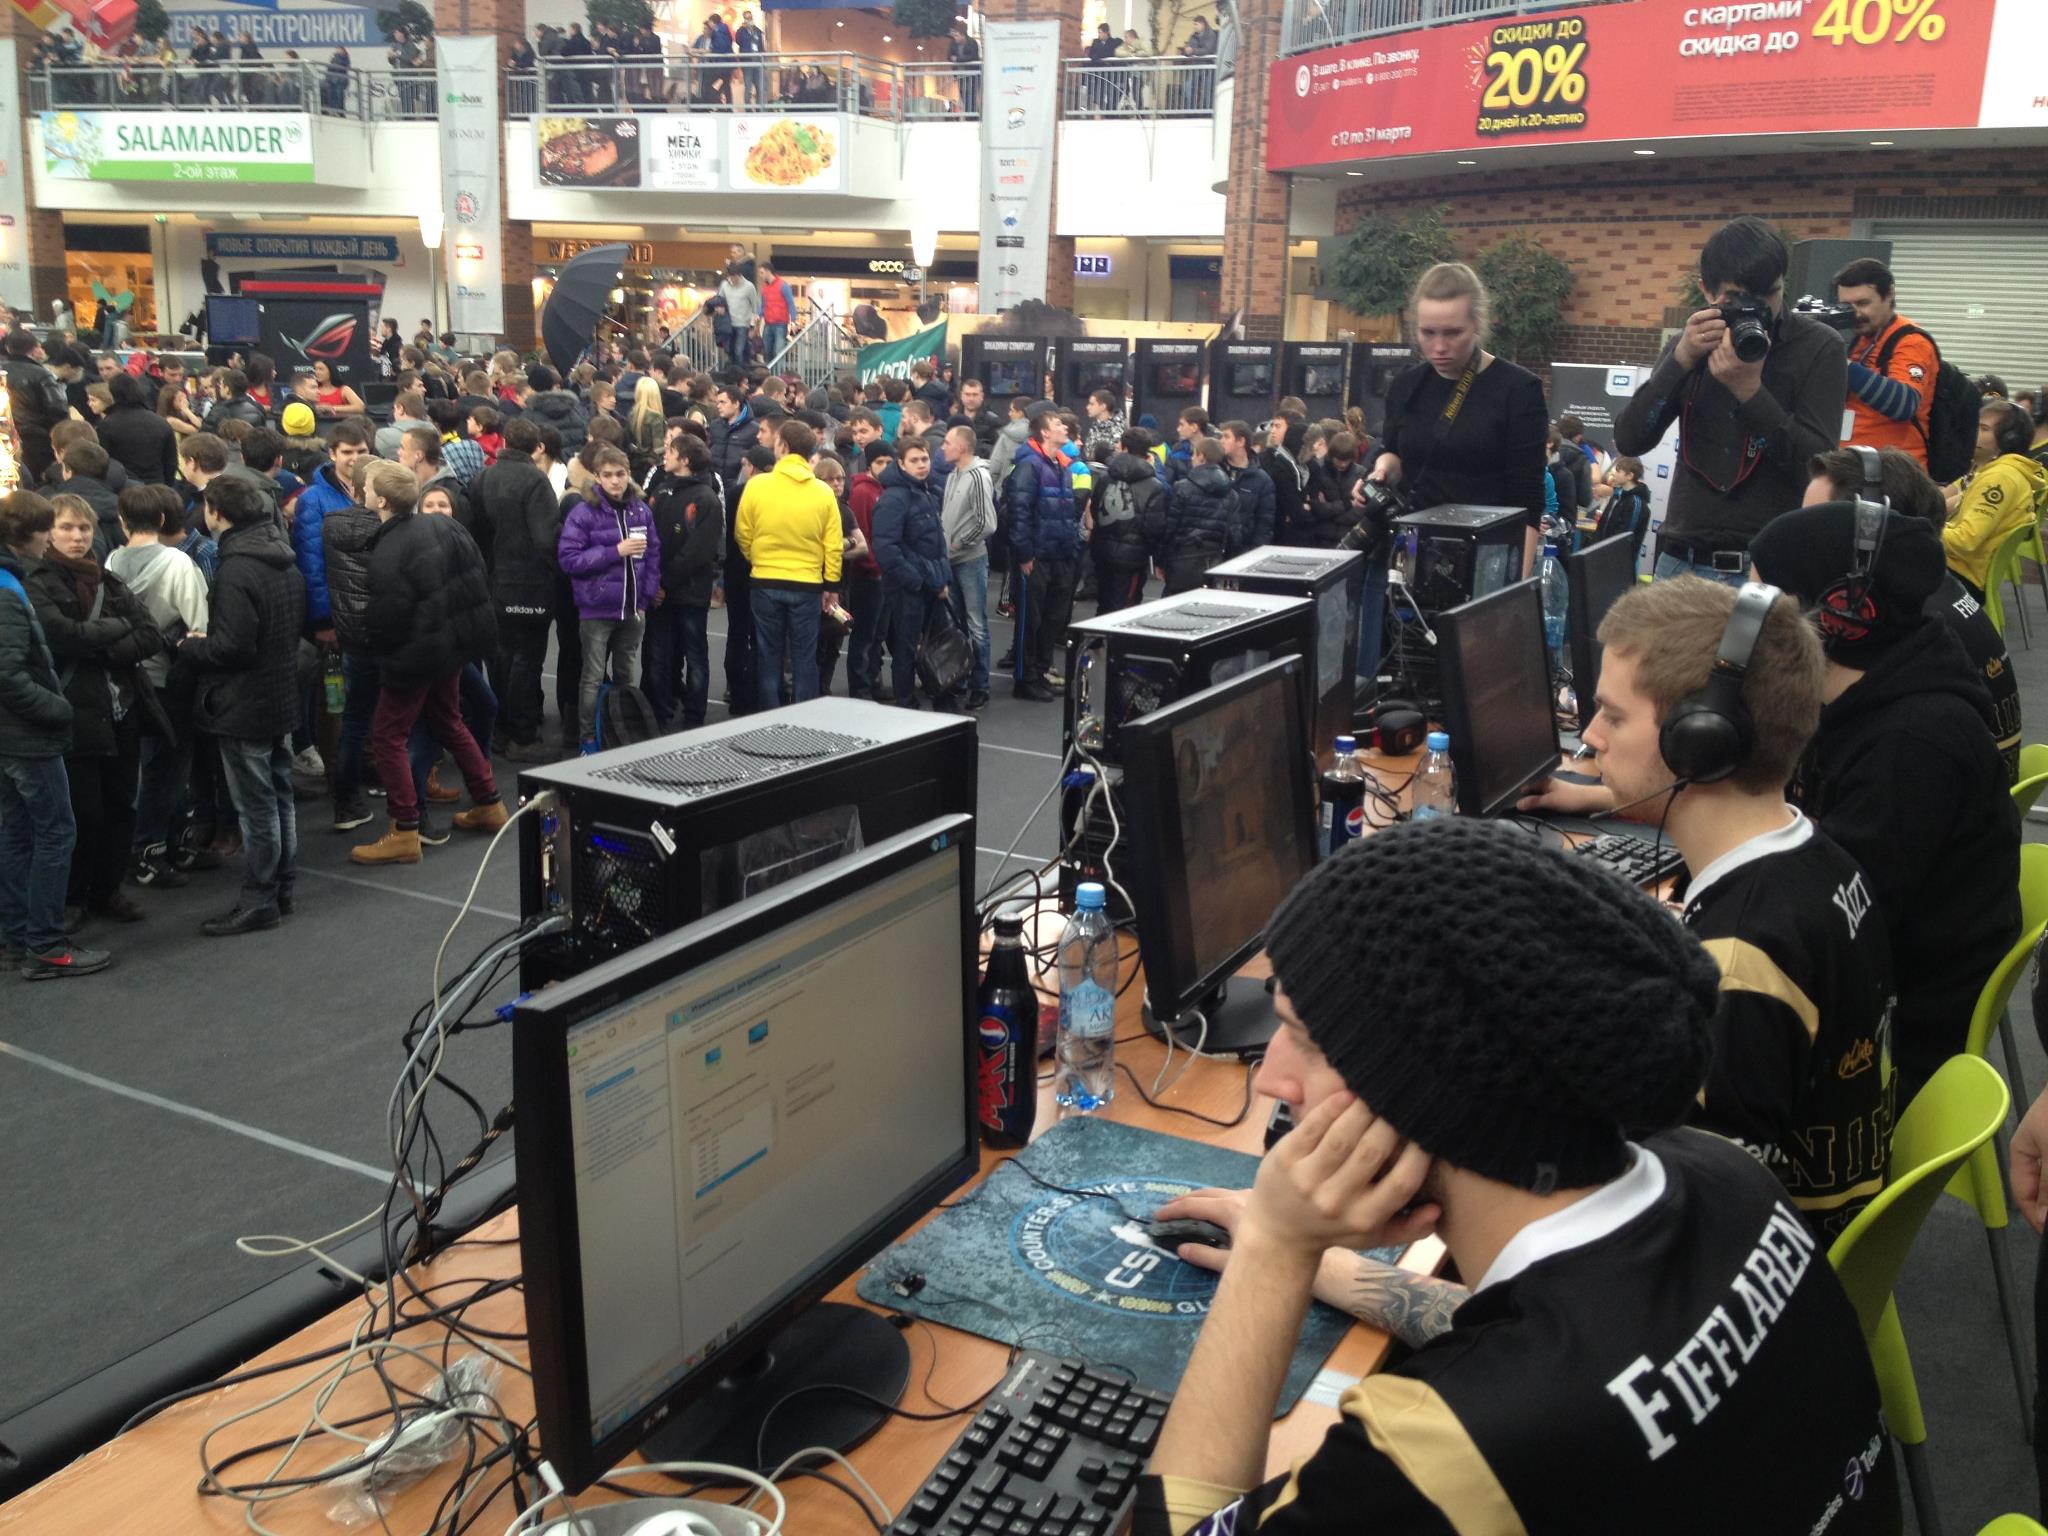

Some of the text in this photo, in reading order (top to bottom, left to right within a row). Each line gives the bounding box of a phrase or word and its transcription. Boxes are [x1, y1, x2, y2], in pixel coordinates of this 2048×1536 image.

[226, 14, 366, 43] ЭЛЕКТРОНИКИ
[1684, 0, 1803, 31] с картами
[1812, 0, 1946, 45] 40%
[1493, 19, 1582, 44] СКИДКИ ДО
[1679, 31, 1799, 57] скидка до
[1483, 42, 1586, 108] 20%
[1478, 117, 1492, 130] 20
[1491, 114, 1520, 131] дней
[1528, 112, 1585, 127] 20-летию
[117, 125, 284, 153] SALAMANDER
[667, 135, 702, 148] МЕГА
[1331, 135, 1339, 146] с
[1350, 132, 1364, 144] по
[1365, 127, 1376, 142] 31
[1376, 126, 1412, 144] марта
[668, 149, 701, 159] ХИМКИ
[173, 163, 238, 180] 2-ой этаж
[505, 605, 534, 614] adidas
[1832, 871, 1873, 940] XIZT
[1605, 1200, 1816, 1461] FIFFLAREN
